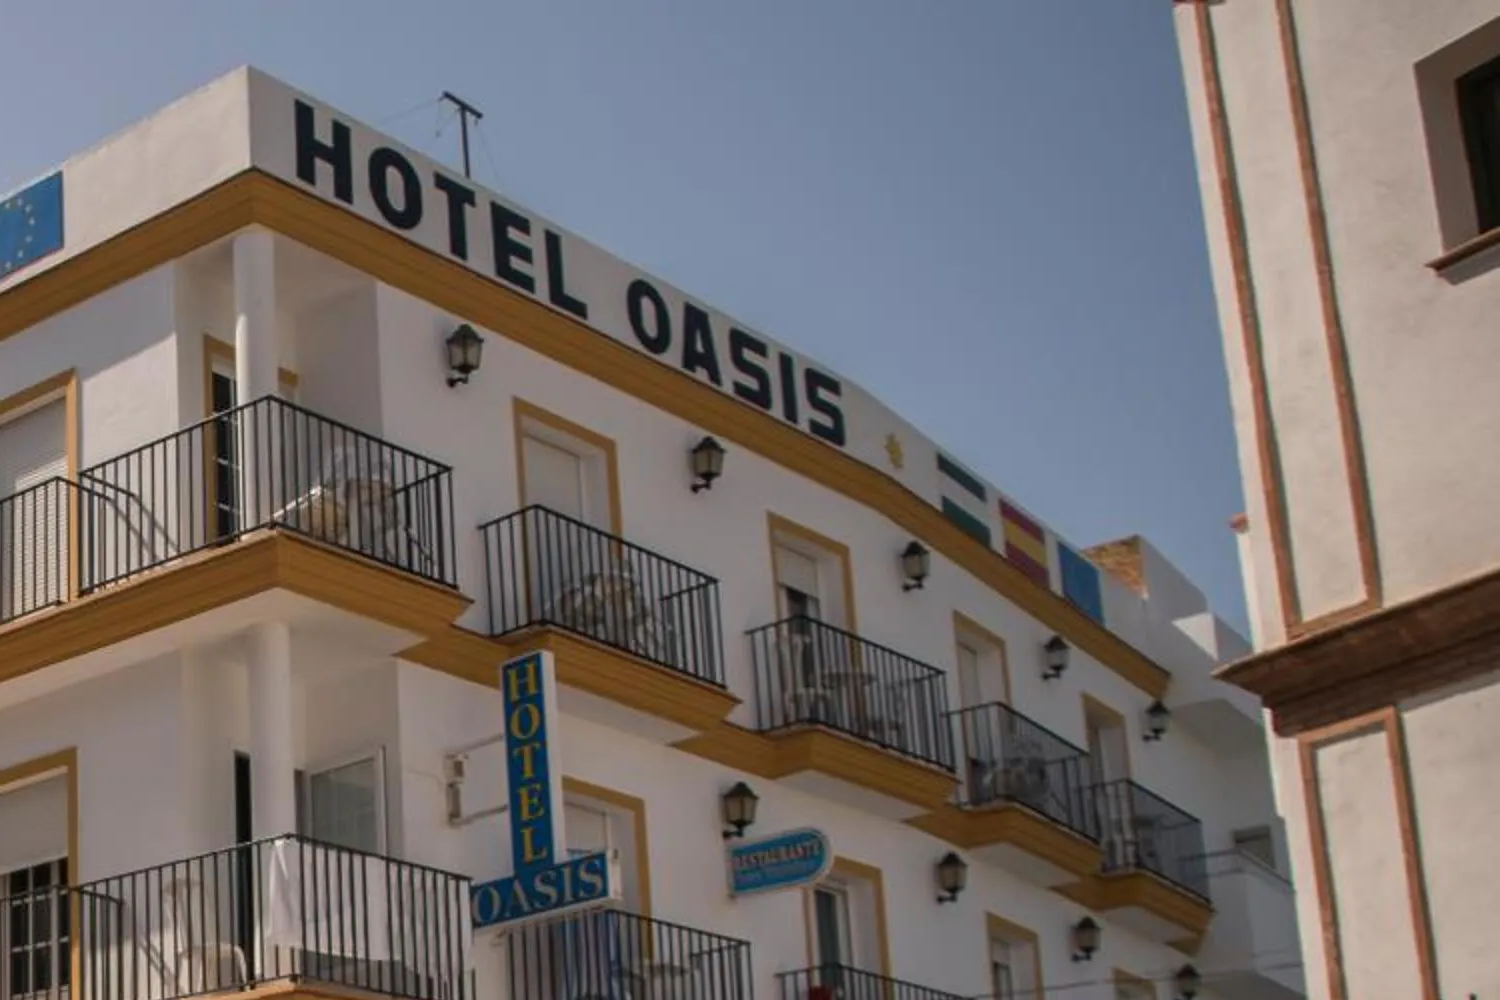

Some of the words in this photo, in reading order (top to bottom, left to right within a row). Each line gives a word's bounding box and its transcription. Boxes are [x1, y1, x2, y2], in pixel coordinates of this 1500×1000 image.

[294, 98, 587, 321] HOTEL
[626, 278, 847, 447] OASIS
[507, 662, 548, 865] HOTEL
[472, 857, 604, 926] OASIS
